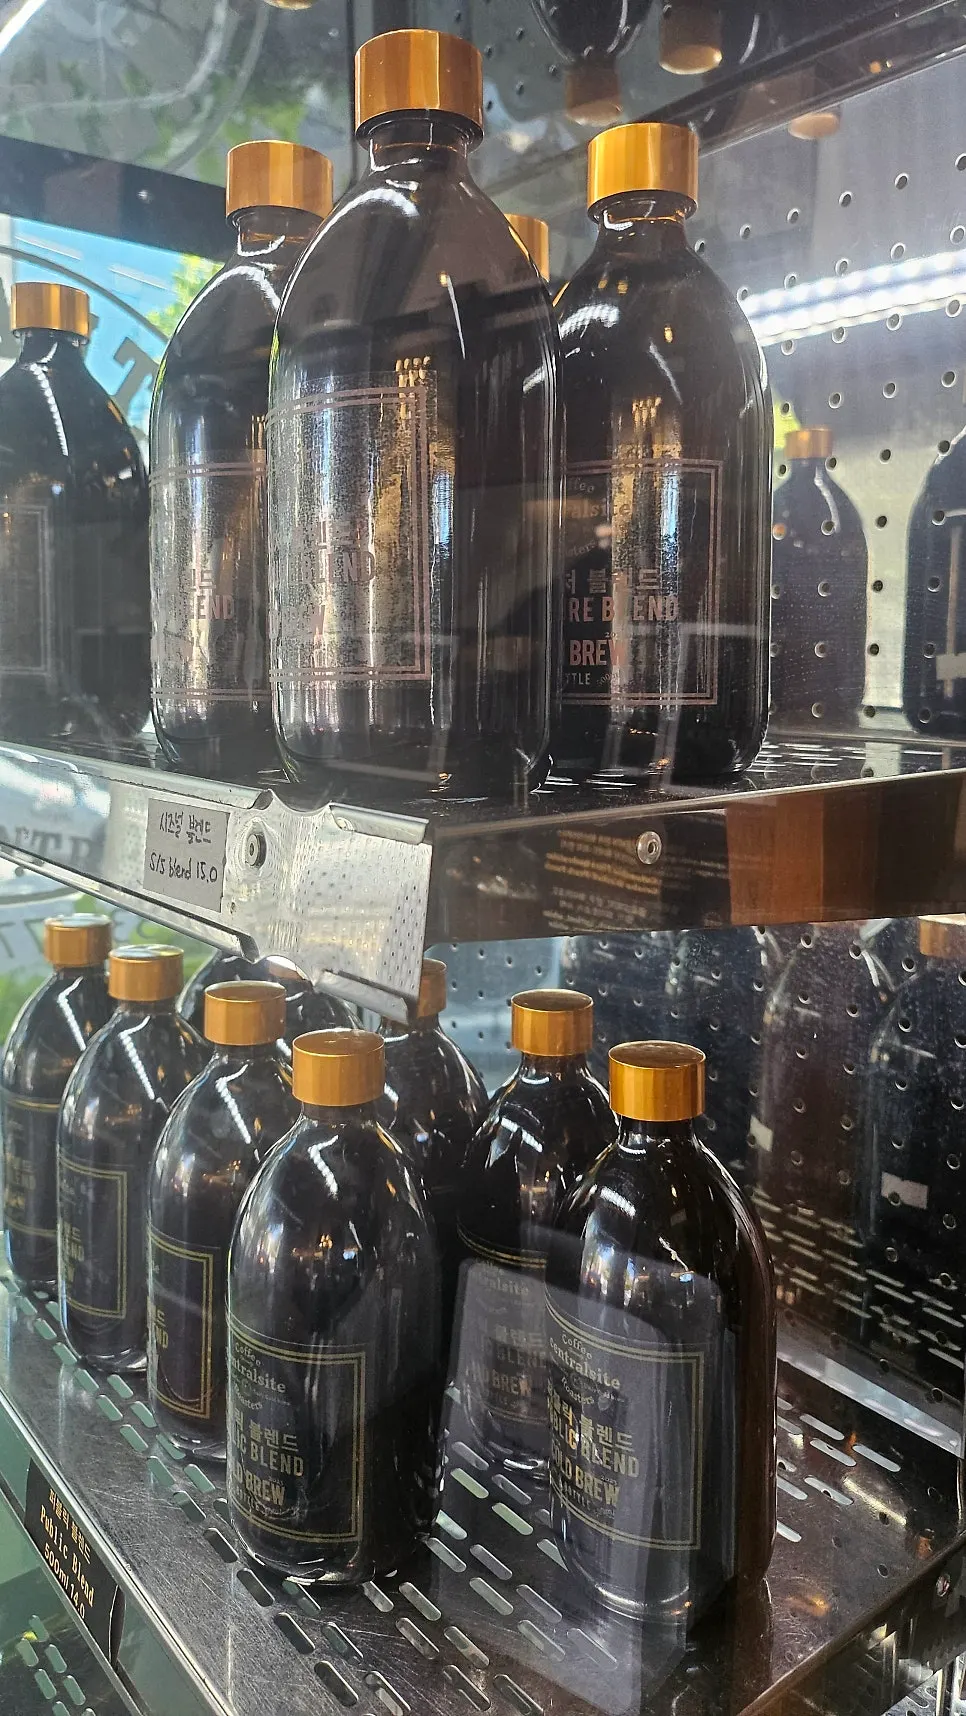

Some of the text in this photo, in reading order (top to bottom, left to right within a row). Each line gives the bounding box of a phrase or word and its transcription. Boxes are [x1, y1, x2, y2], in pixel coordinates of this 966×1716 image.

[187, 594, 234, 620] END
[568, 595, 679, 622] RE BEND
[569, 640, 626, 666] BREW
[565, 672, 591, 685] TTLE
[186, 814, 212, 845] 블렌드
[168, 856, 192, 880] blend
[196, 861, 218, 883] 15.0
[561, 1333, 593, 1360] Coffee
[232, 1357, 286, 1393] ntralsite
[249, 1419, 299, 1452] 블렌드
[580, 1413, 636, 1454] 블렌드
[250, 1440, 304, 1477] BLEND
[580, 1434, 641, 1478] BLEND
[245, 1469, 285, 1506] BREW
[575, 1465, 620, 1507] BREW
[49, 1488, 92, 1565] 퍼블릭 블렌드
[40, 1504, 95, 1608] Public Blend
[44, 1542, 85, 1620] 500ml 14.0
